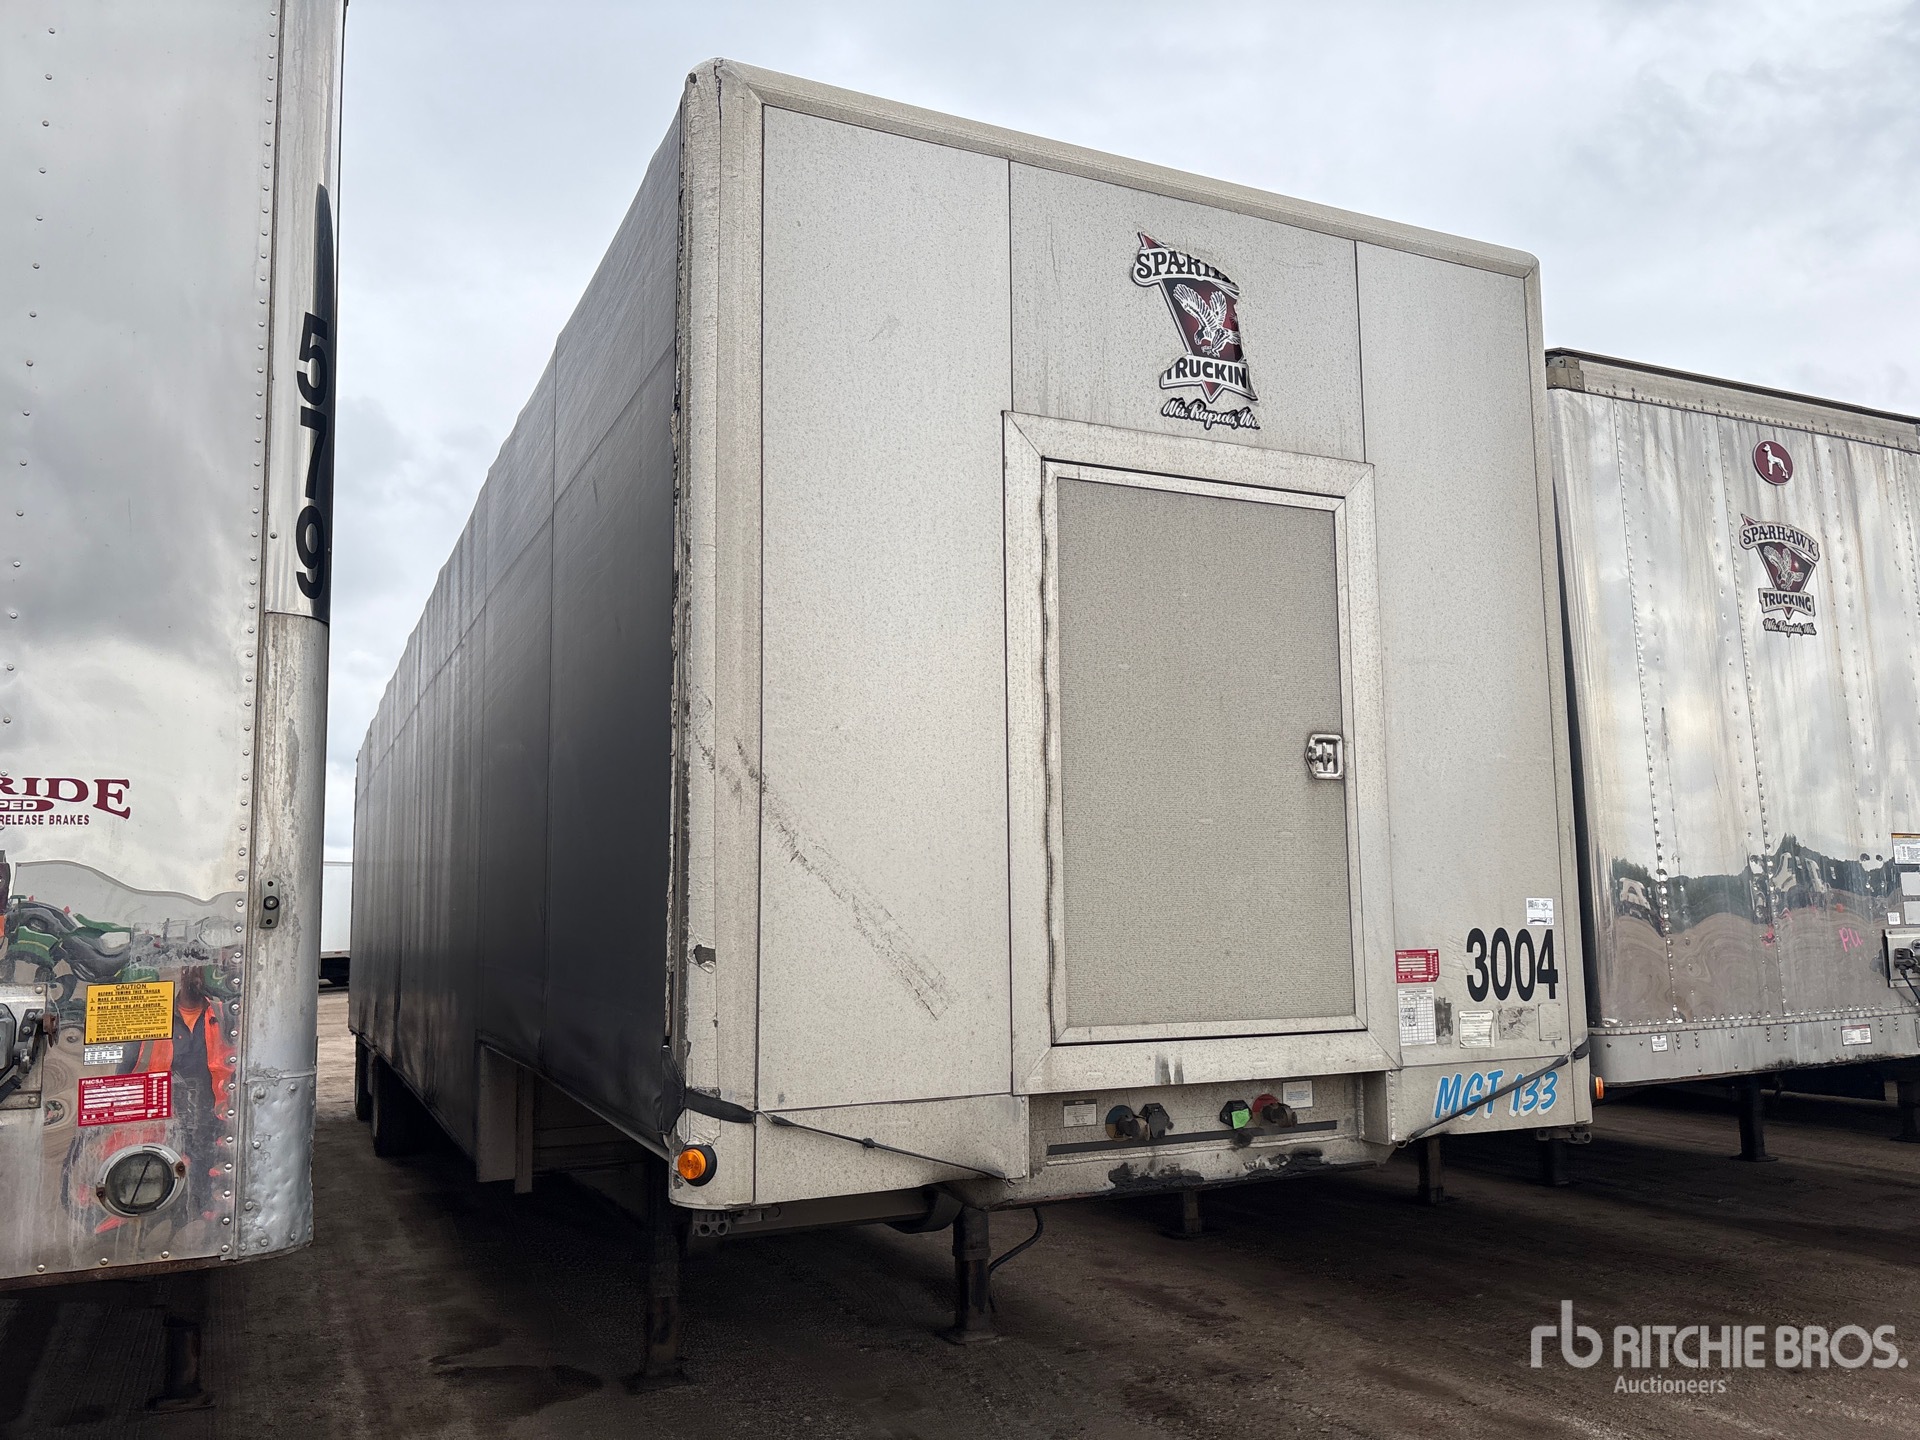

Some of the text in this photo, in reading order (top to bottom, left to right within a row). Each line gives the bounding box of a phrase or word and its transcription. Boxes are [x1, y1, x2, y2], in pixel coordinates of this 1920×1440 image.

[1136, 250, 1233, 284] SPAR
[1161, 398, 1188, 419] Wis.
[296, 312, 328, 599] 579
[1742, 525, 1818, 557] SPARHAWK
[1762, 592, 1812, 612] TRUCKING
[49, 814, 90, 826] BRAKES
[1466, 927, 1558, 1002] 3004
[1434, 1069, 1558, 1119] MGT 133
